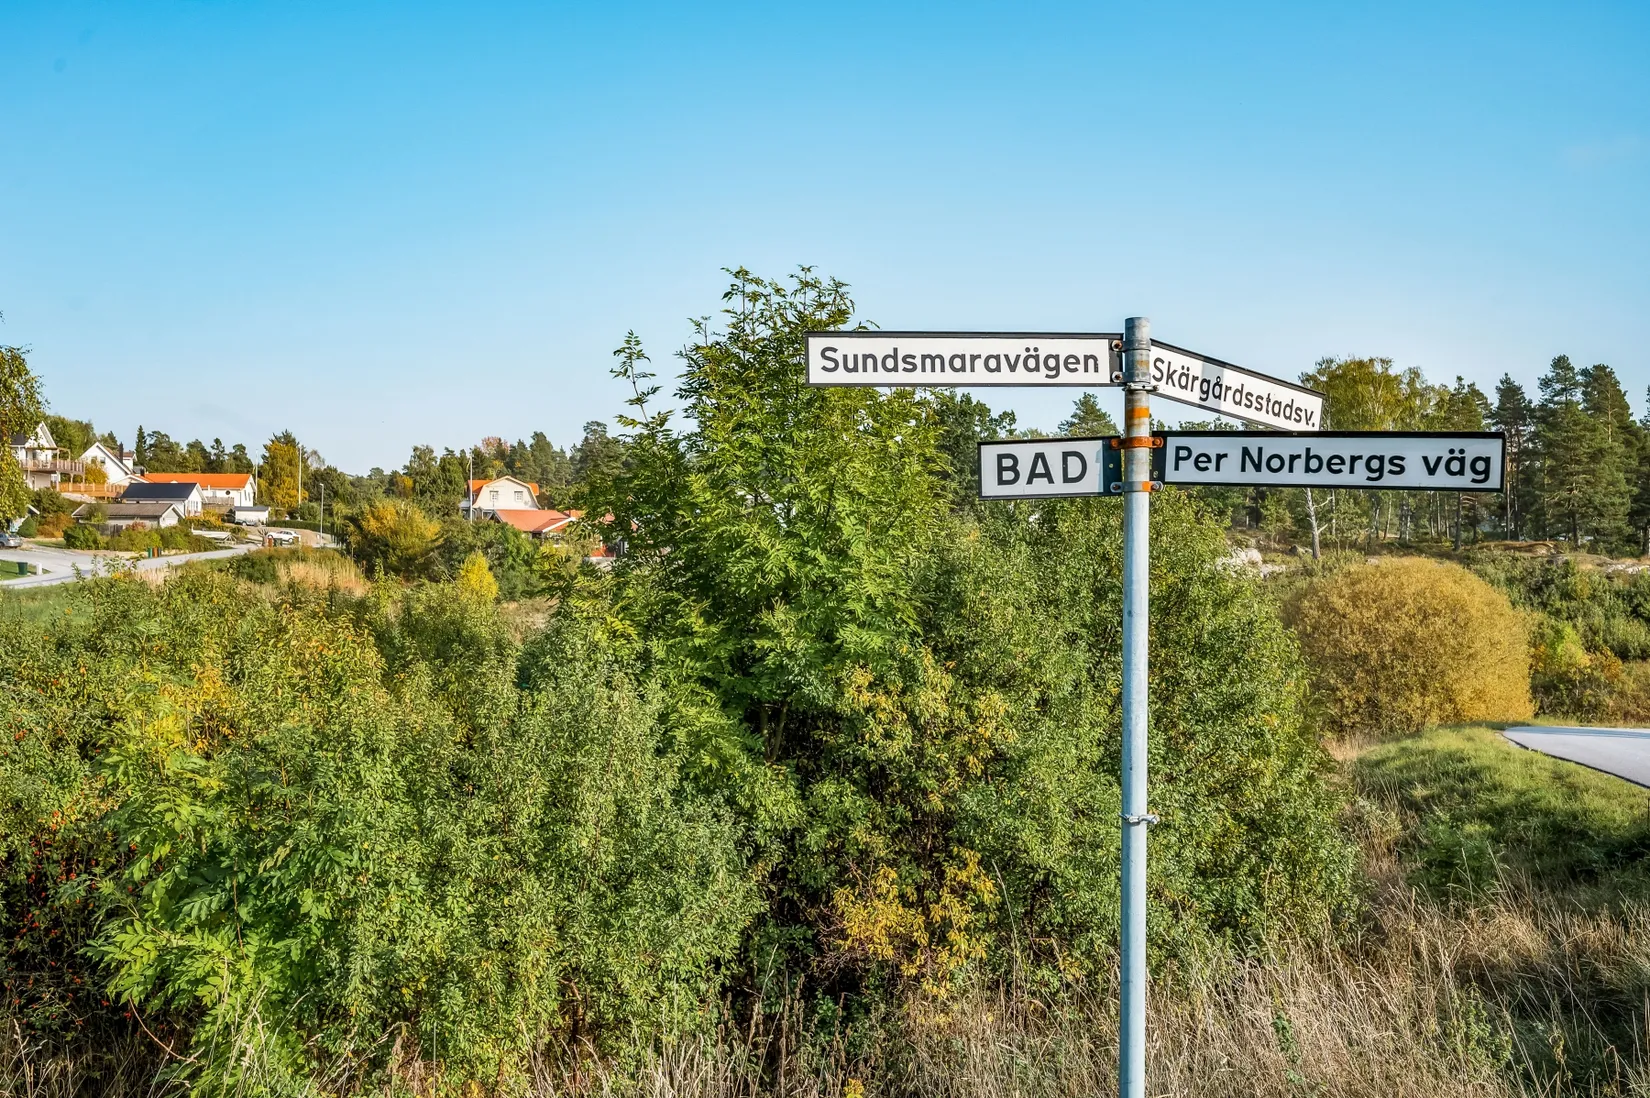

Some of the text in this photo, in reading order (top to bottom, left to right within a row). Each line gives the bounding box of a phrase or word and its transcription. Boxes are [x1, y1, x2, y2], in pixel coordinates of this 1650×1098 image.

[819, 346, 1100, 379] Sundsmaravägen
[1151, 356, 1316, 428] Skärgårdsstadsv.
[996, 450, 1088, 486] BAD
[1173, 445, 1492, 484] Per Norbergs väg
